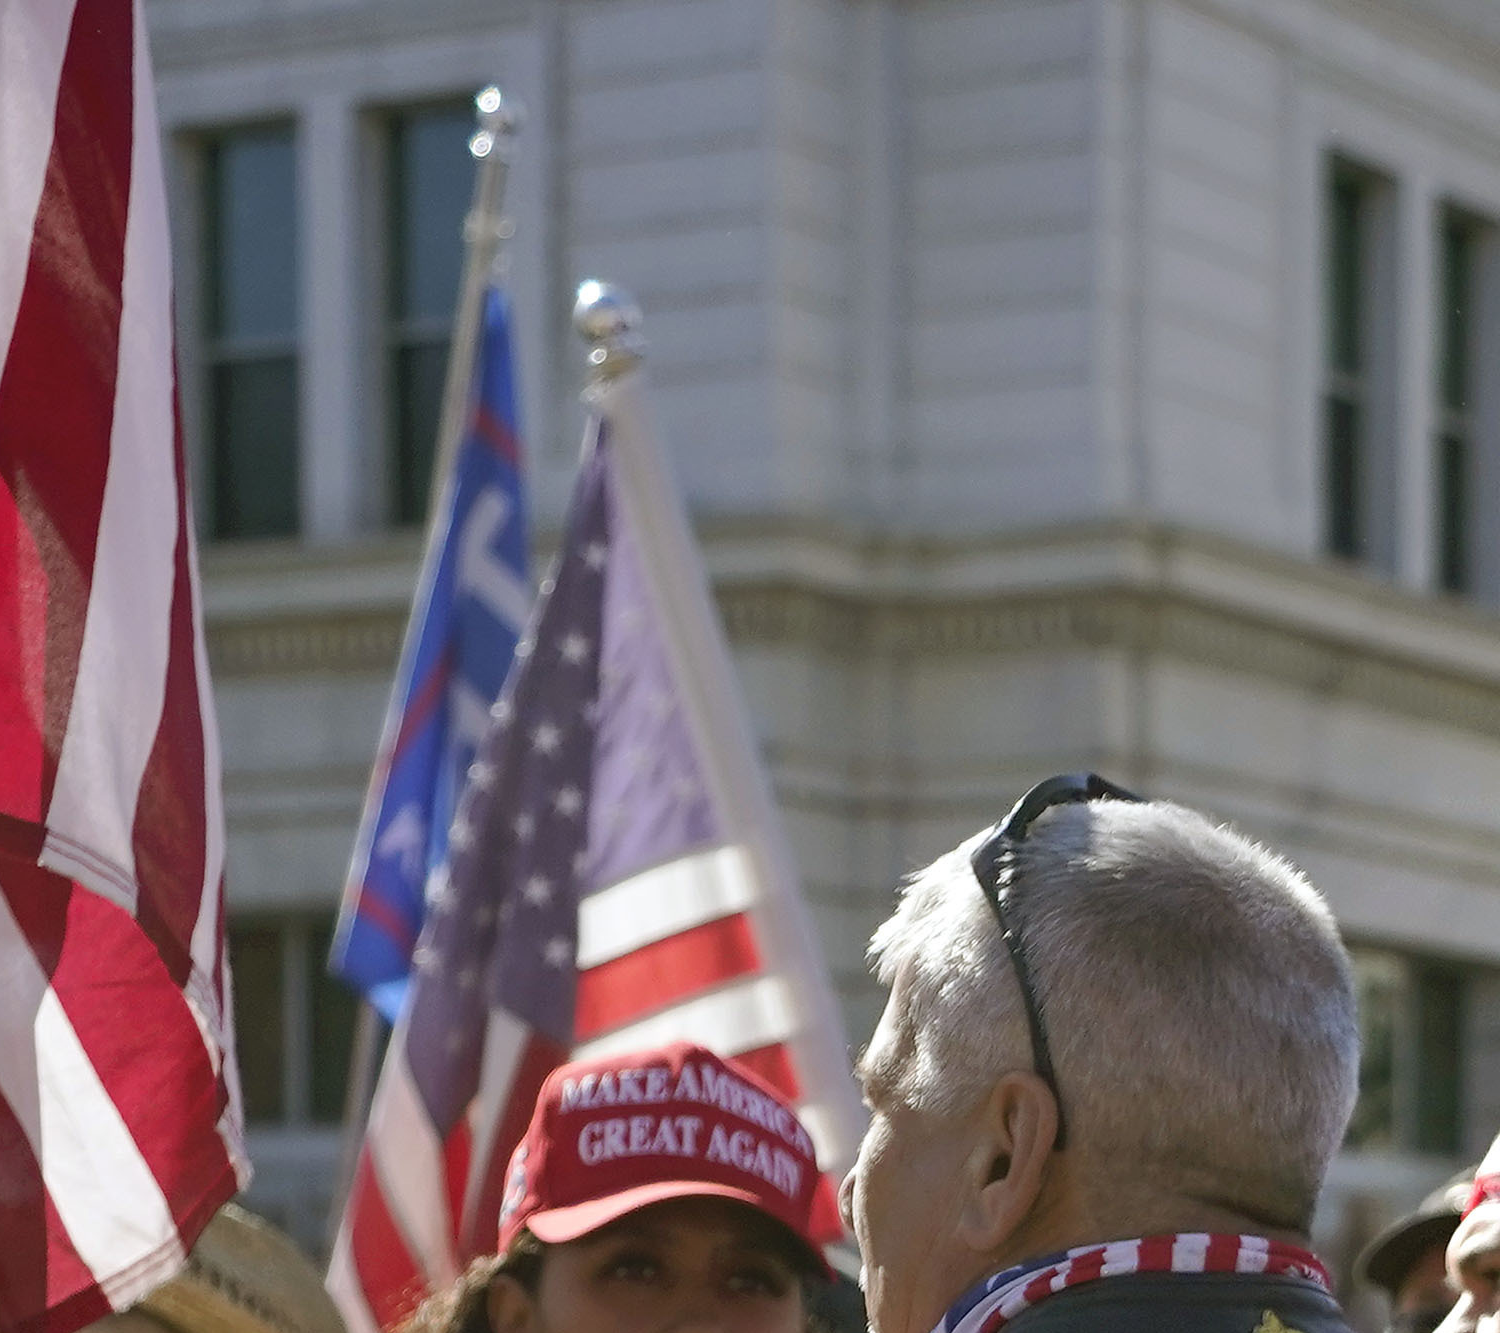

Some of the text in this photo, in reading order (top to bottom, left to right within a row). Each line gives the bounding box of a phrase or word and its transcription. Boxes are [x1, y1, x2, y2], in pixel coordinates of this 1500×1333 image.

[558, 1060, 815, 1160] MAKE AMERICA
[577, 1114, 803, 1199] GREAT AGAIN
